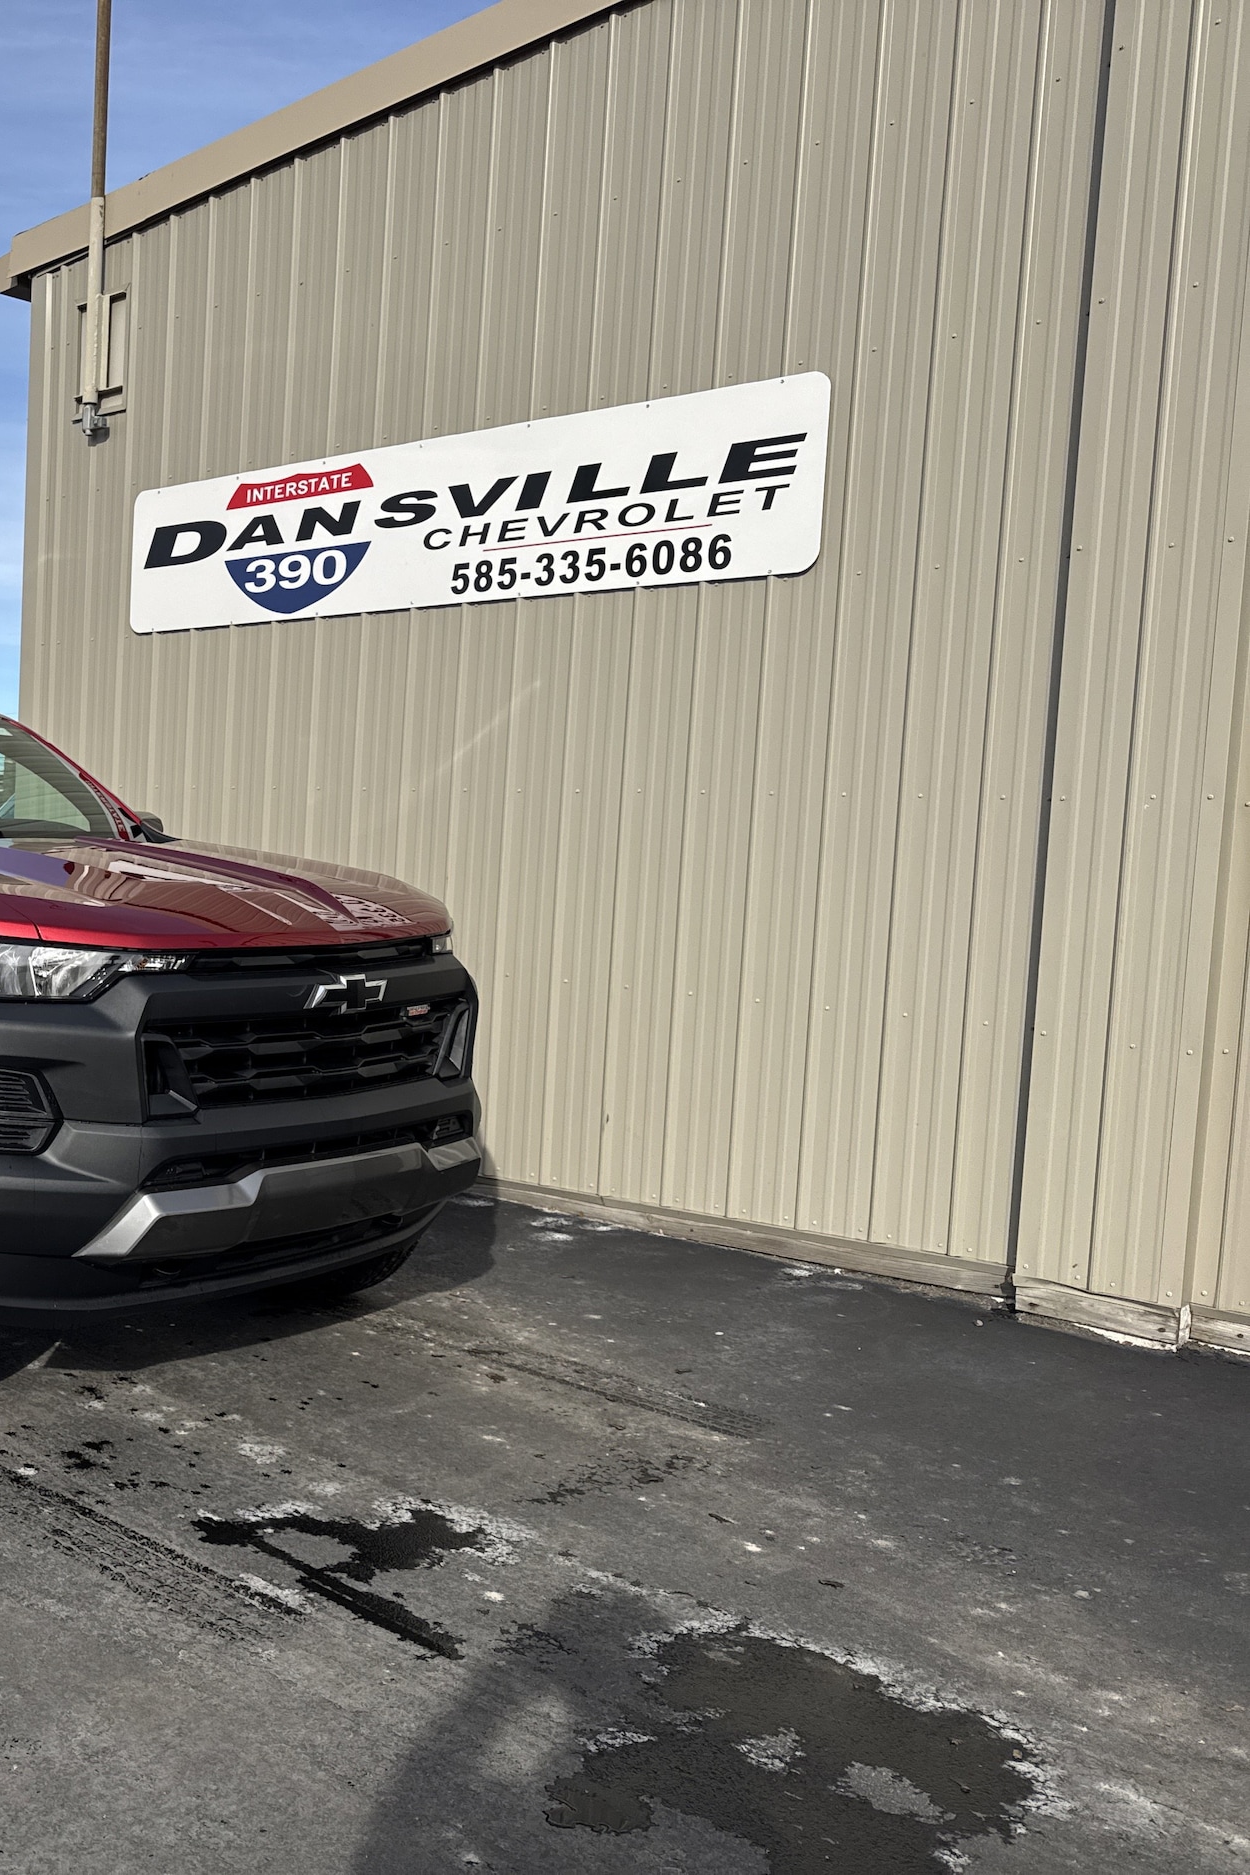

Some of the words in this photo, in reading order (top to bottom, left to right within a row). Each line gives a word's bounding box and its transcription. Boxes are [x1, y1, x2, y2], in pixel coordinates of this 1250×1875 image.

[246, 472, 353, 503] INTERSTATE
[423, 483, 790, 550] CHEVROLET
[244, 549, 347, 594] 390
[450, 533, 733, 595] 585-335-6086
